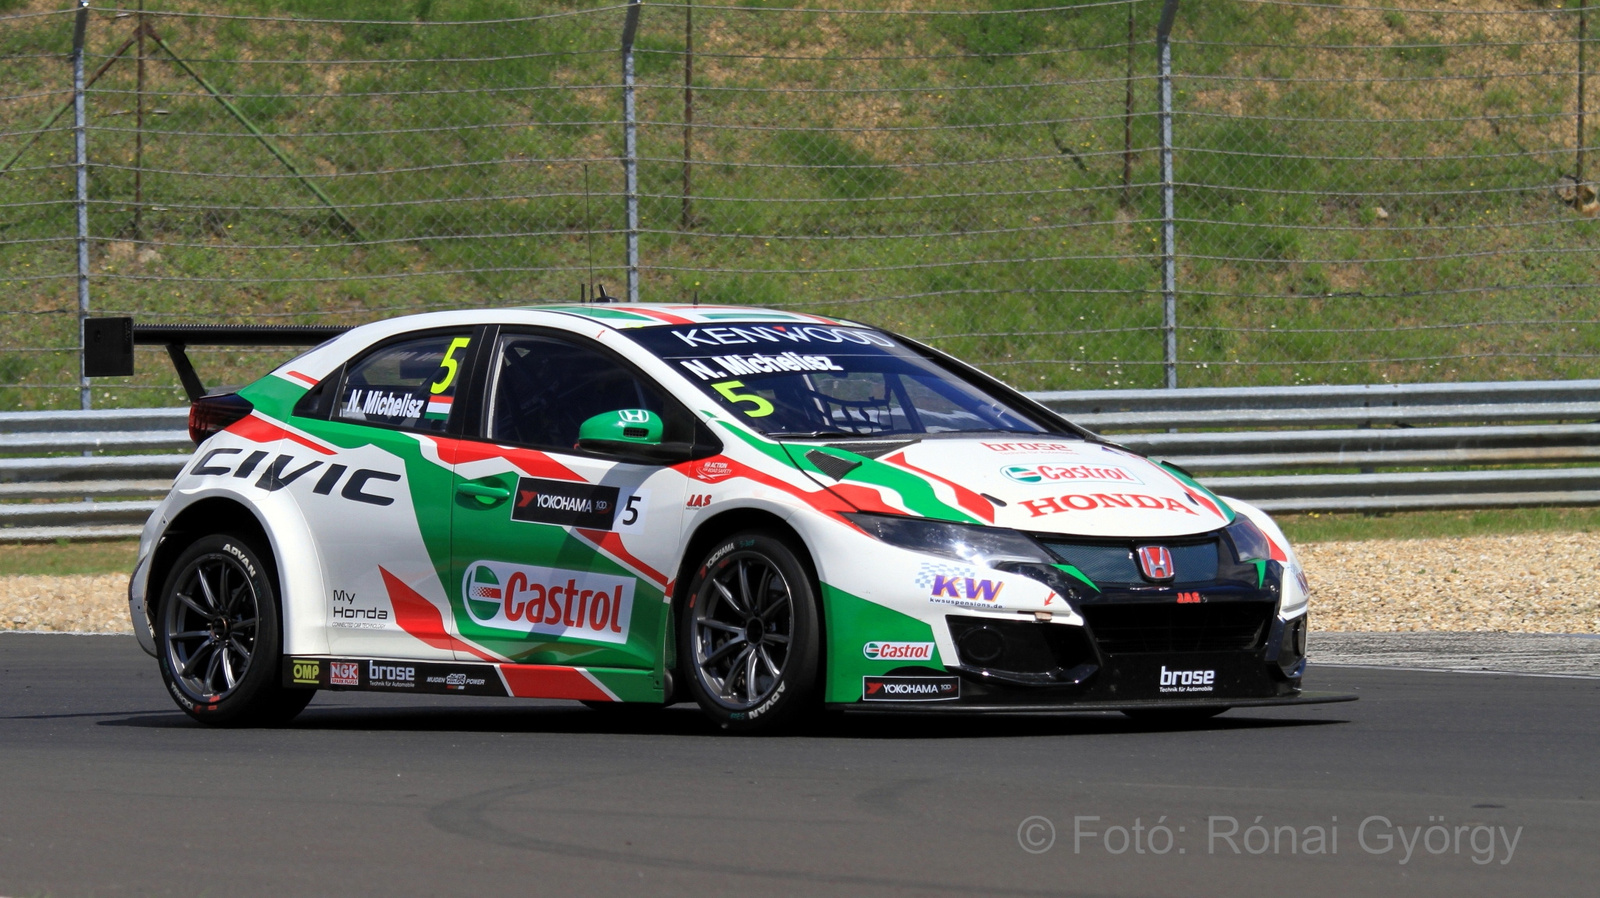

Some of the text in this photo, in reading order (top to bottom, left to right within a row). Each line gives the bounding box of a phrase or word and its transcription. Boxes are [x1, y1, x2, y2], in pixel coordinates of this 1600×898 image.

[671, 326, 895, 348] KENWOOD
[430, 337, 471, 394] 5
[681, 352, 844, 381] N. Michelisz
[346, 388, 425, 419] N. Michelisz
[711, 380, 775, 418] 5
[980, 442, 1073, 452] brose
[190, 447, 402, 506] CIVIC
[1036, 465, 1135, 481] Castrol
[536, 493, 593, 514] YOKOHAMA
[622, 496, 642, 526] 5
[686, 494, 712, 508] JAS
[1018, 493, 1200, 518] HONDA
[222, 543, 256, 577] ADVAN
[706, 542, 735, 568] YOKOHAMA
[333, 589, 356, 605] My
[931, 575, 1004, 603] KW
[1177, 592, 1200, 603] JAS
[504, 571, 623, 633] Castrol
[929, 597, 1003, 609] kwsuspensions.de
[333, 606, 388, 620] Honda
[880, 643, 929, 658] Castrol
[293, 664, 319, 679] OMP
[331, 664, 358, 680] NGK
[369, 660, 415, 681] brose
[1160, 665, 1215, 686] brose
[883, 683, 938, 694] YOKOHAMA
[748, 680, 785, 719] ADVAN
